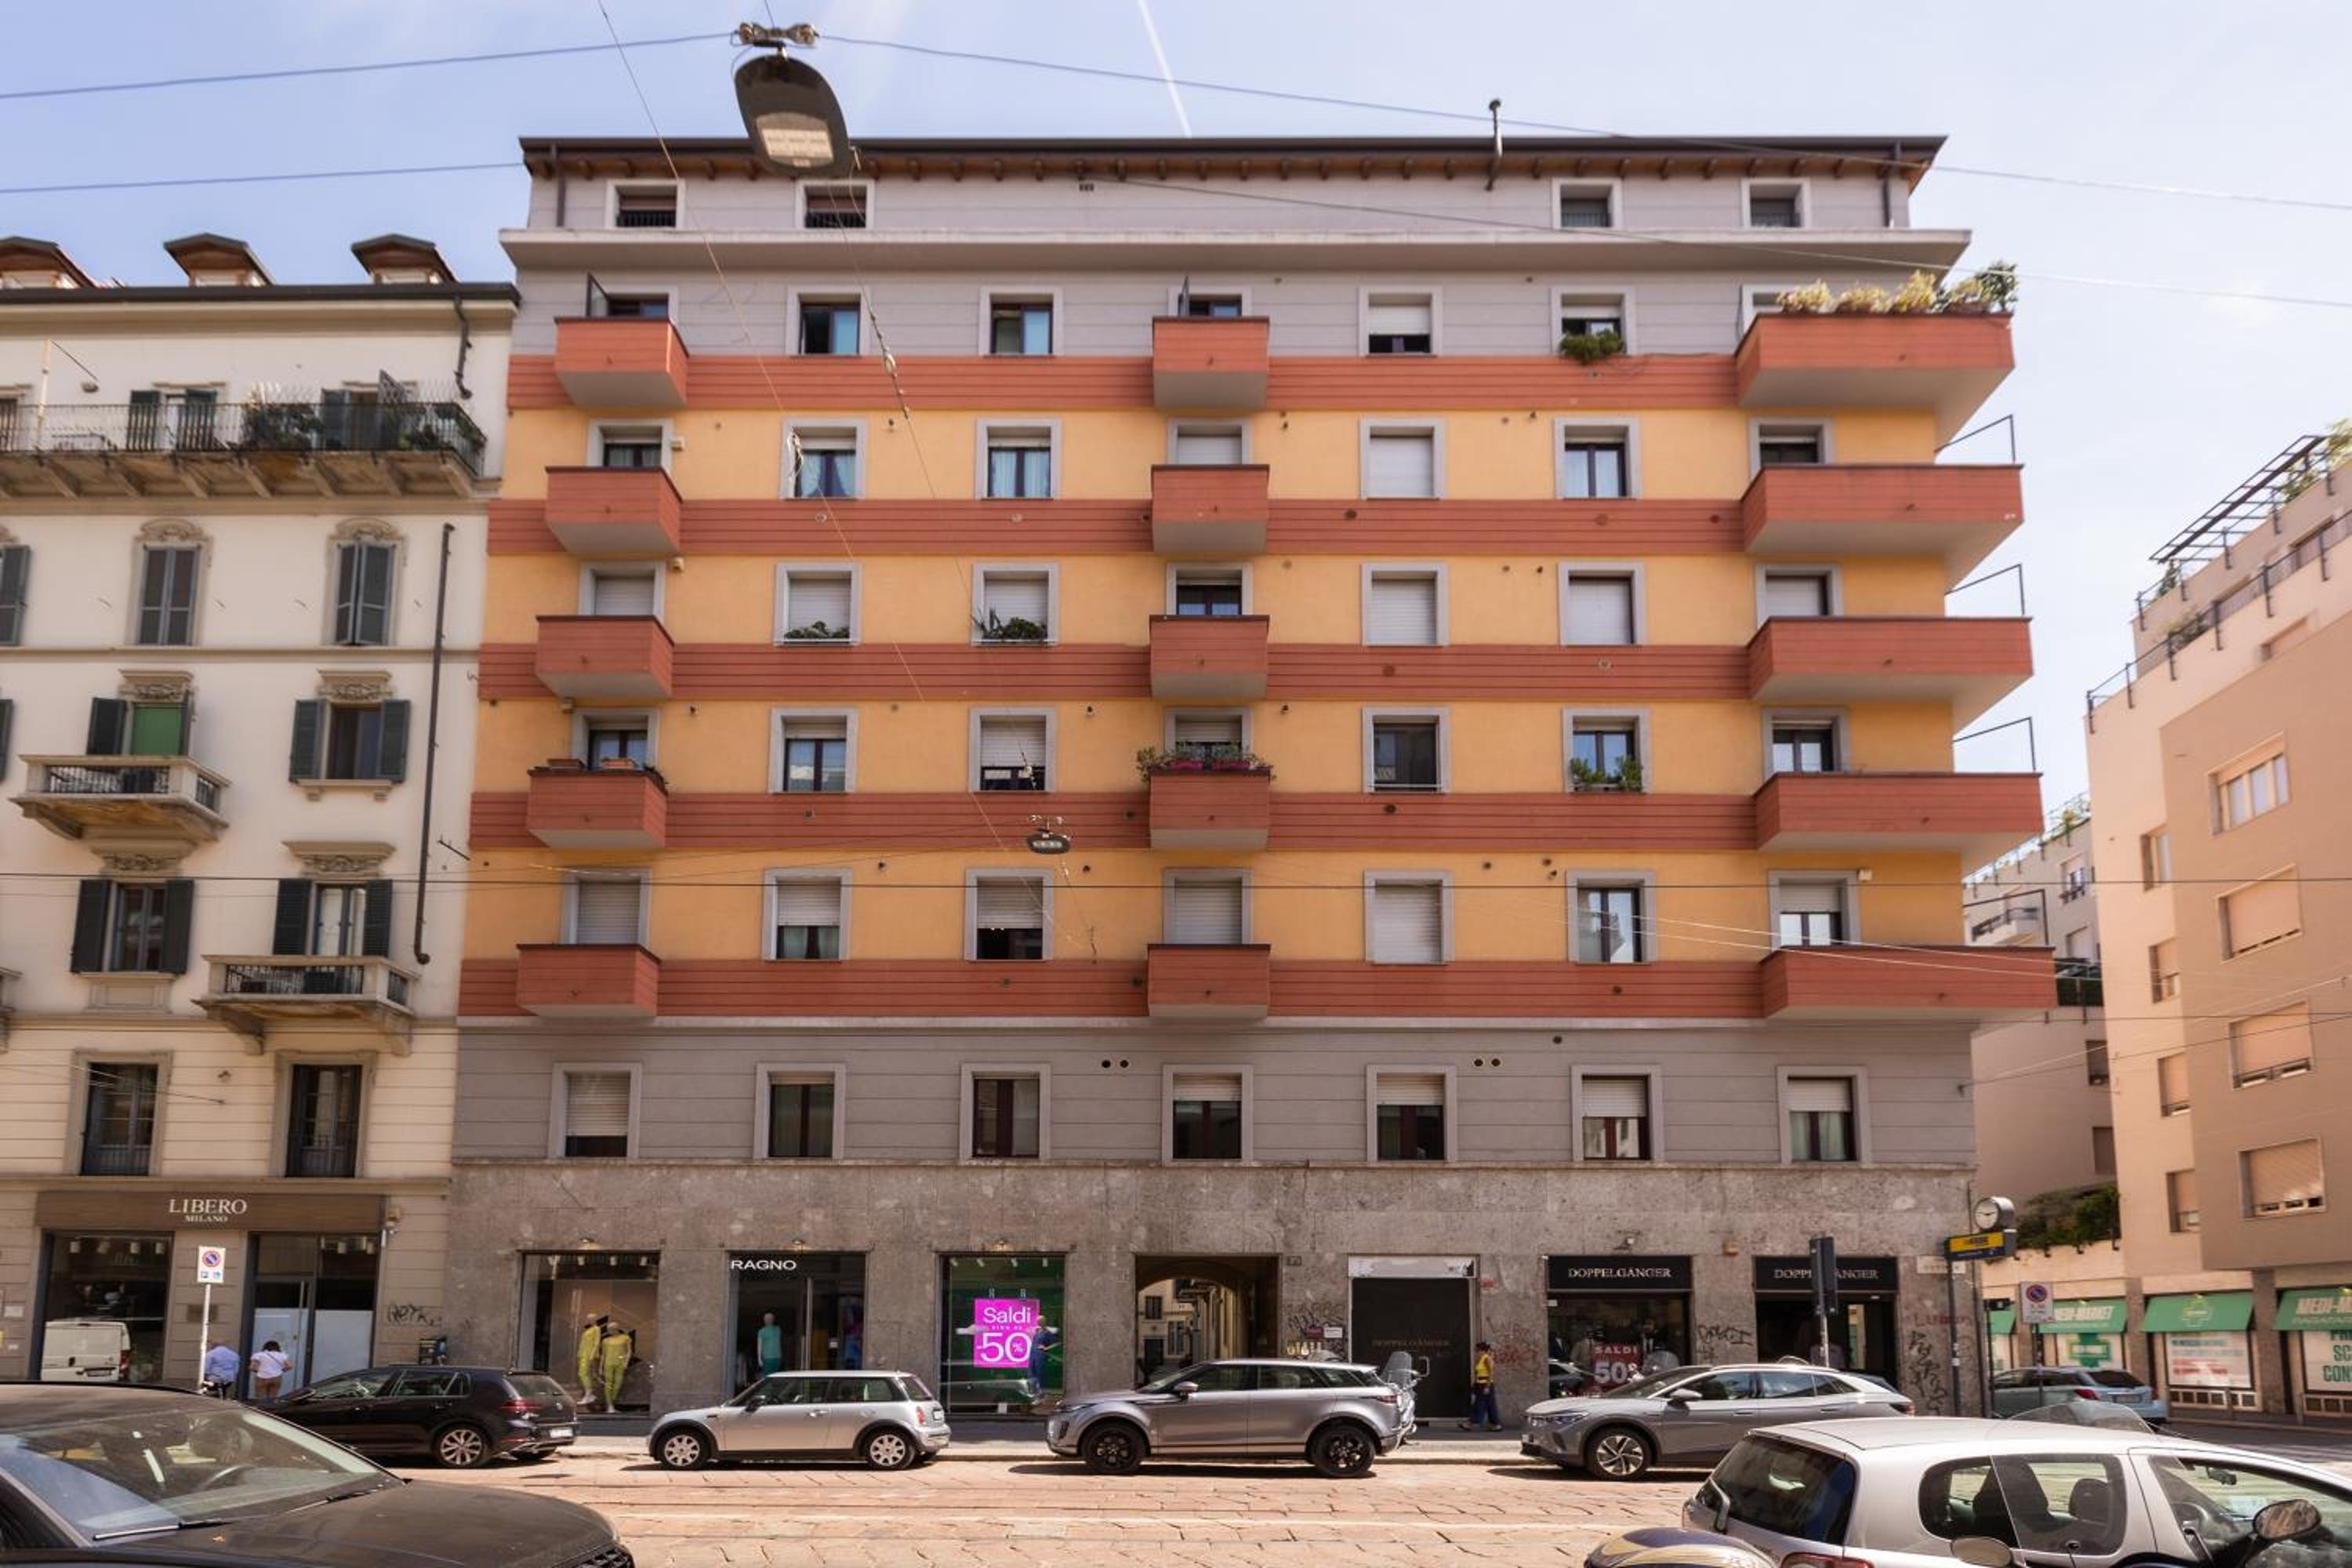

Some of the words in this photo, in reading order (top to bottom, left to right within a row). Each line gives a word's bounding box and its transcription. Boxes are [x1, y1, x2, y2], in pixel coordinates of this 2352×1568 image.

[169, 1199, 248, 1214] LIBERO
[730, 1259, 797, 1271] RAGNO
[984, 1306, 1031, 1324] Saldi
[1595, 1345, 1638, 1355] SALDI
